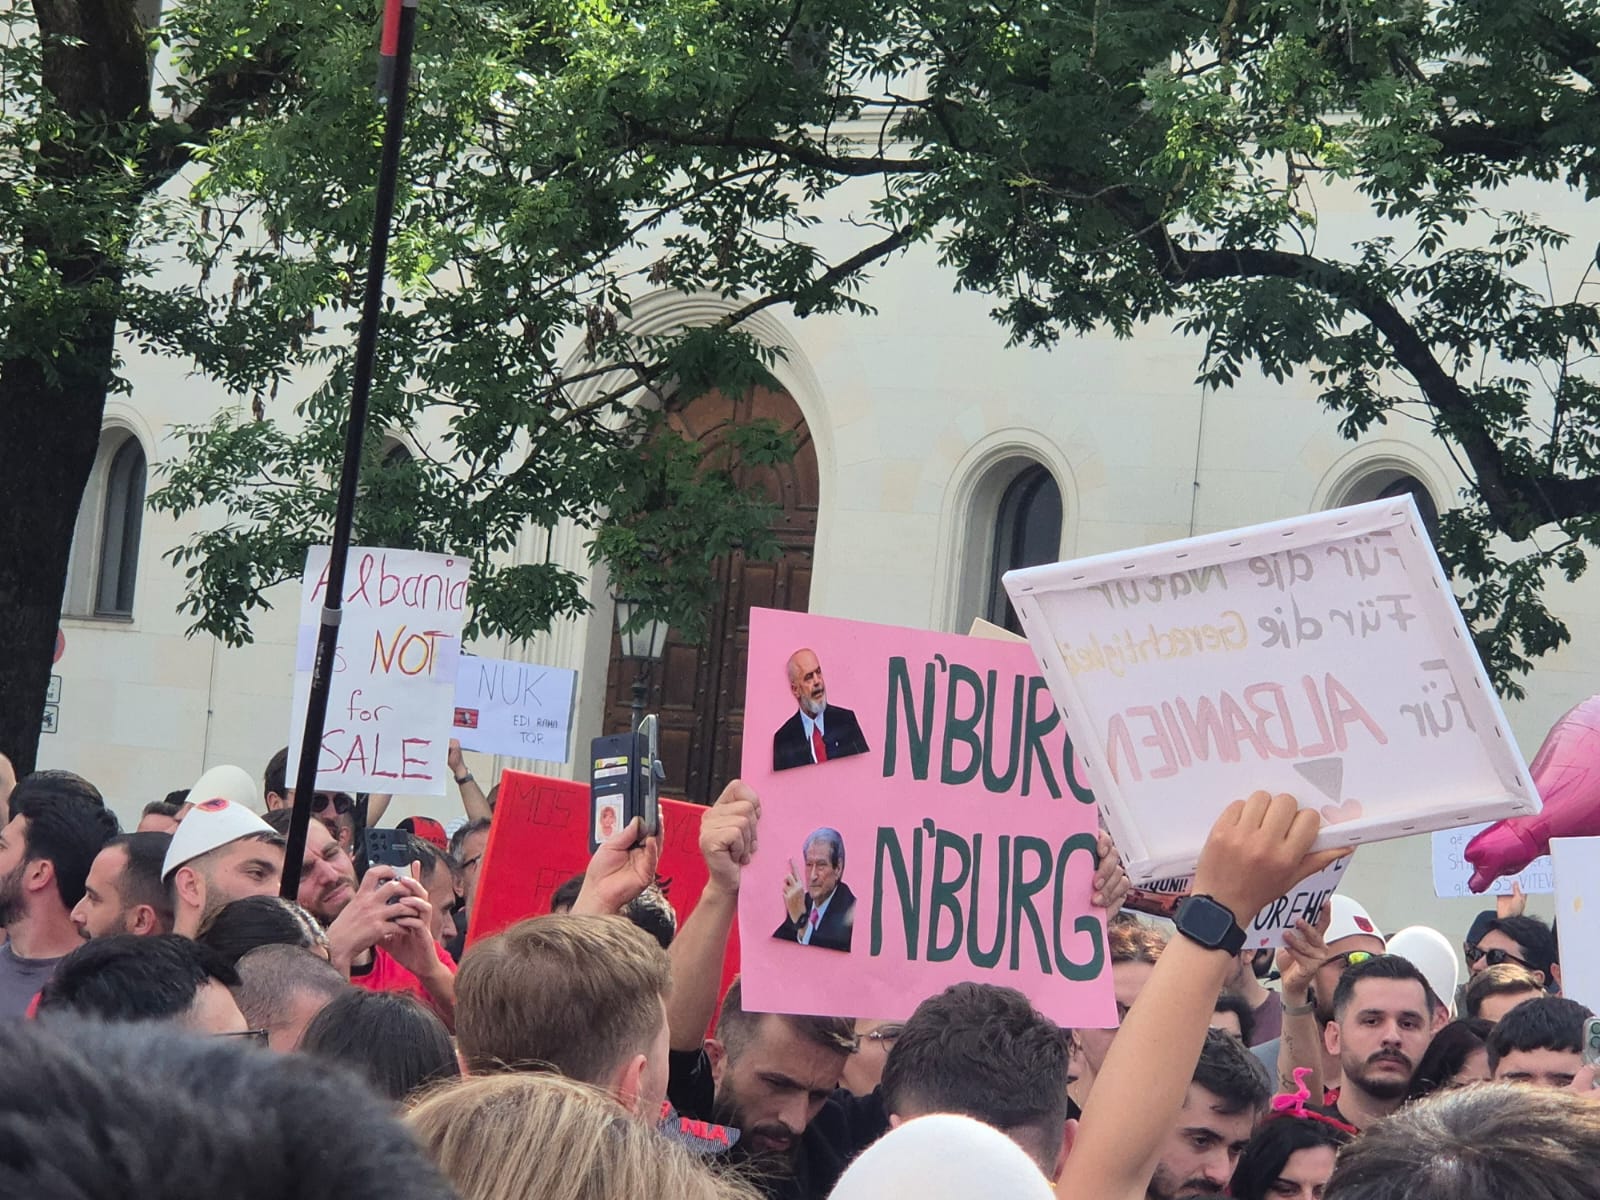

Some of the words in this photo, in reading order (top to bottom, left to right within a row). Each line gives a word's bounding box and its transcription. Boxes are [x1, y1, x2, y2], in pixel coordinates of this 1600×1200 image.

[370, 624, 455, 676] NOT
[346, 688, 394, 722] for
[478, 663, 549, 707] NUK
[513, 714, 531, 728] EDI
[316, 728, 433, 780] SALE
[869, 817, 1106, 982] N'BURG
